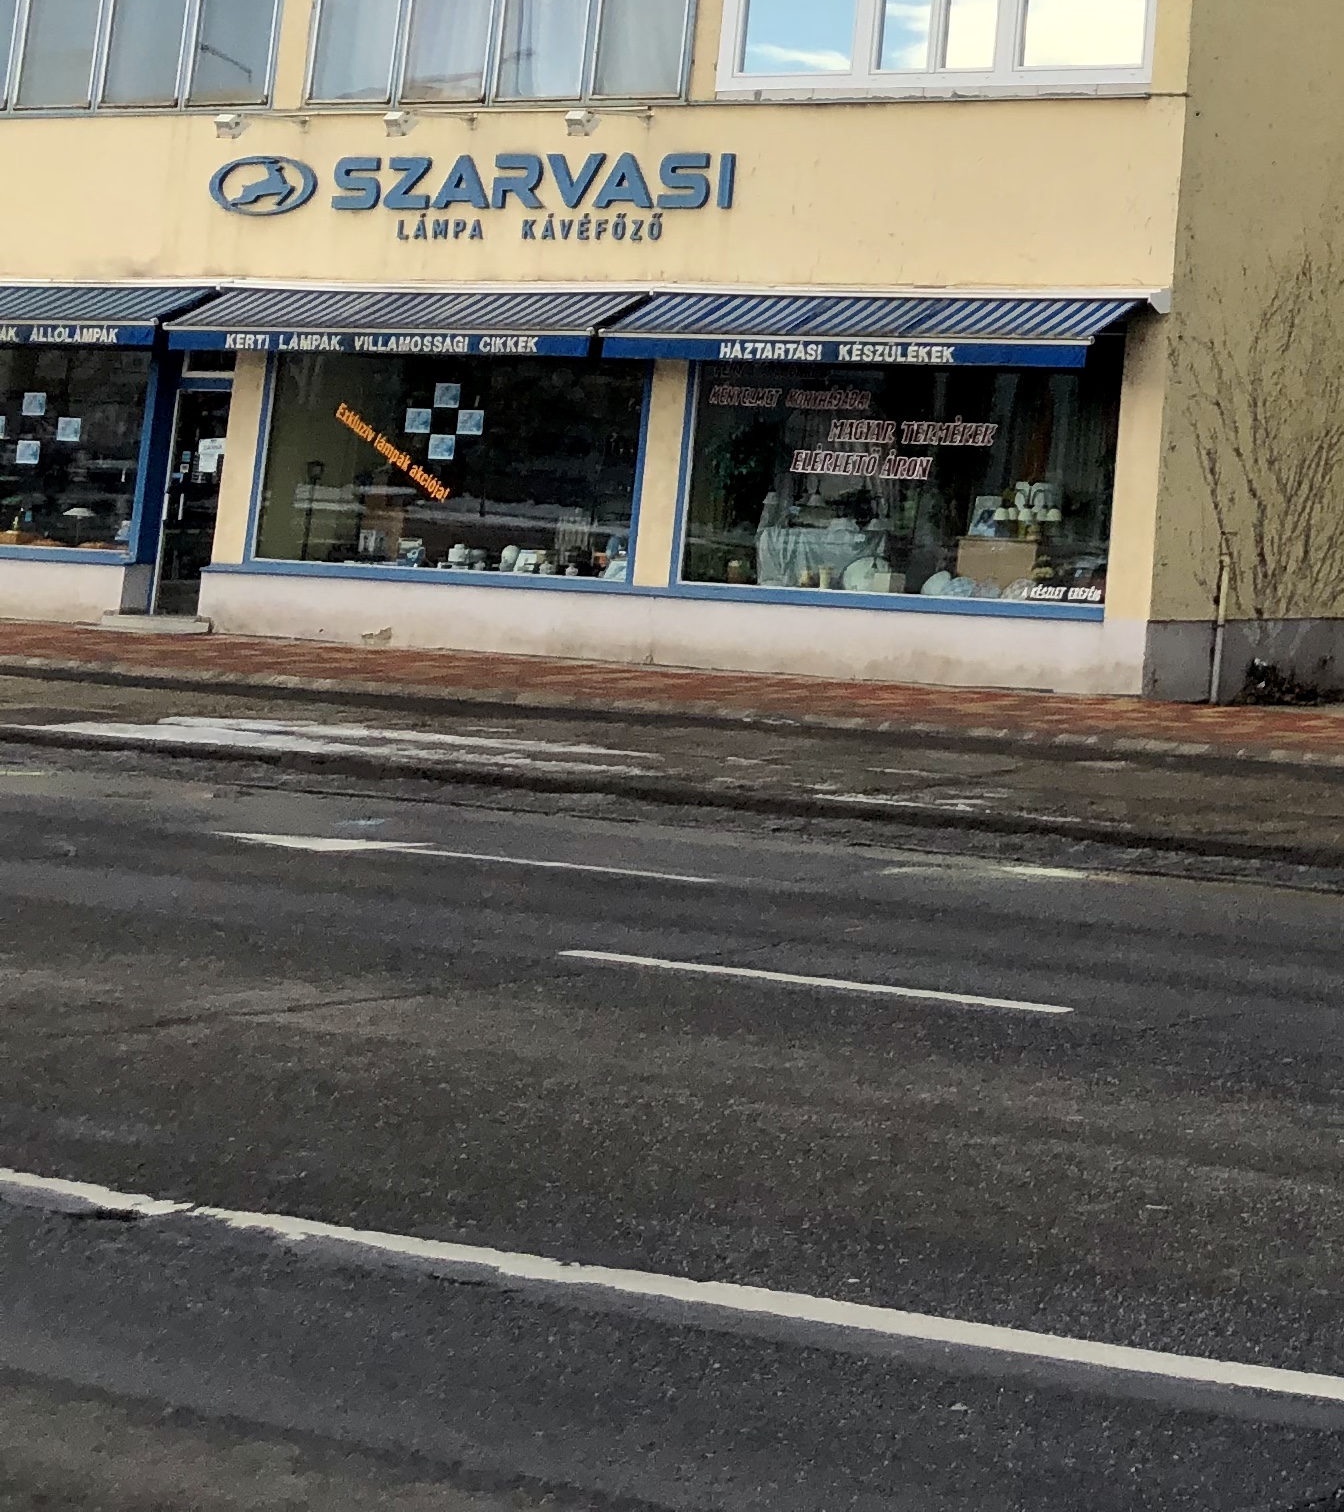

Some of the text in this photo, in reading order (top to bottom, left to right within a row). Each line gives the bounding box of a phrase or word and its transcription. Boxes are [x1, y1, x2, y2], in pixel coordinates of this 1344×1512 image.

[331, 152, 737, 211] SZARVASI
[396, 212, 665, 242] LÁMPA KÁVÉFŐZŐ
[29, 323, 119, 344] ÁLLÓLÁMPÁK
[224, 334, 270, 350] KERTI
[353, 333, 470, 354] VILLAMOSSÁGI
[478, 336, 540, 354] CIKKEK
[718, 341, 956, 364] HÁZTARTÁSI KÉSZÜLÉKEK
[827, 414, 998, 447] MAGYAR TERMÉKEK
[373, 432, 412, 472] lámpák
[878, 448, 934, 481] ÁRON
